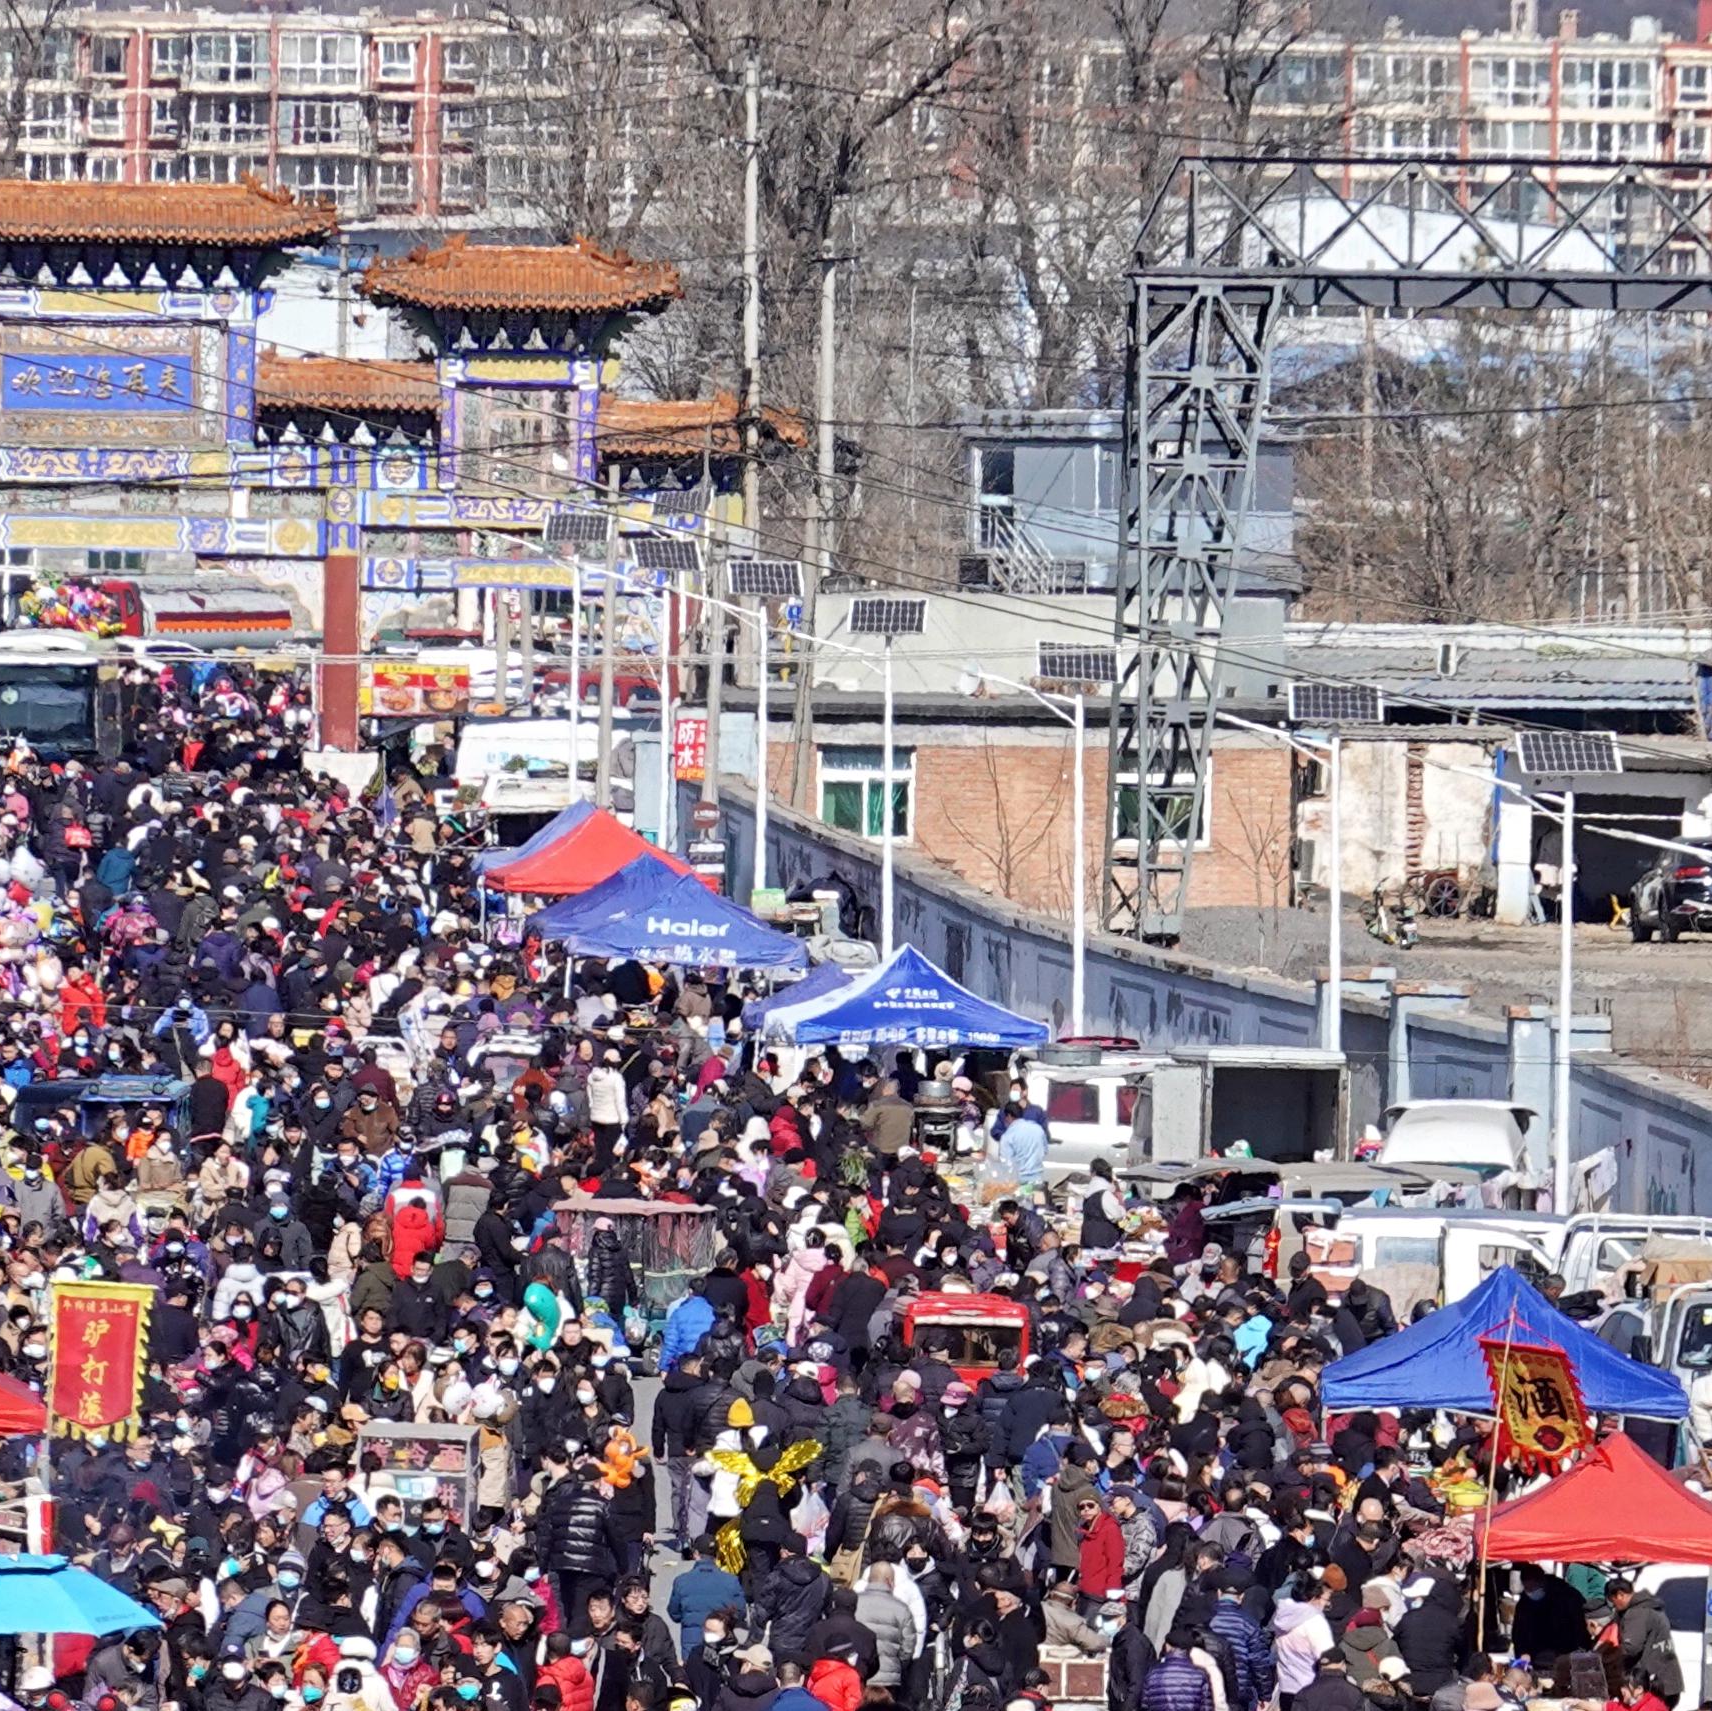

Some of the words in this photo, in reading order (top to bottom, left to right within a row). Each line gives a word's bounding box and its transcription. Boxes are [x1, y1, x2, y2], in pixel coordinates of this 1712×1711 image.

[11, 363, 185, 401] 欢迎您再来
[677, 722, 697, 768] 防水
[647, 917, 731, 937] Haier
[1508, 1370, 1569, 1423] 酒
